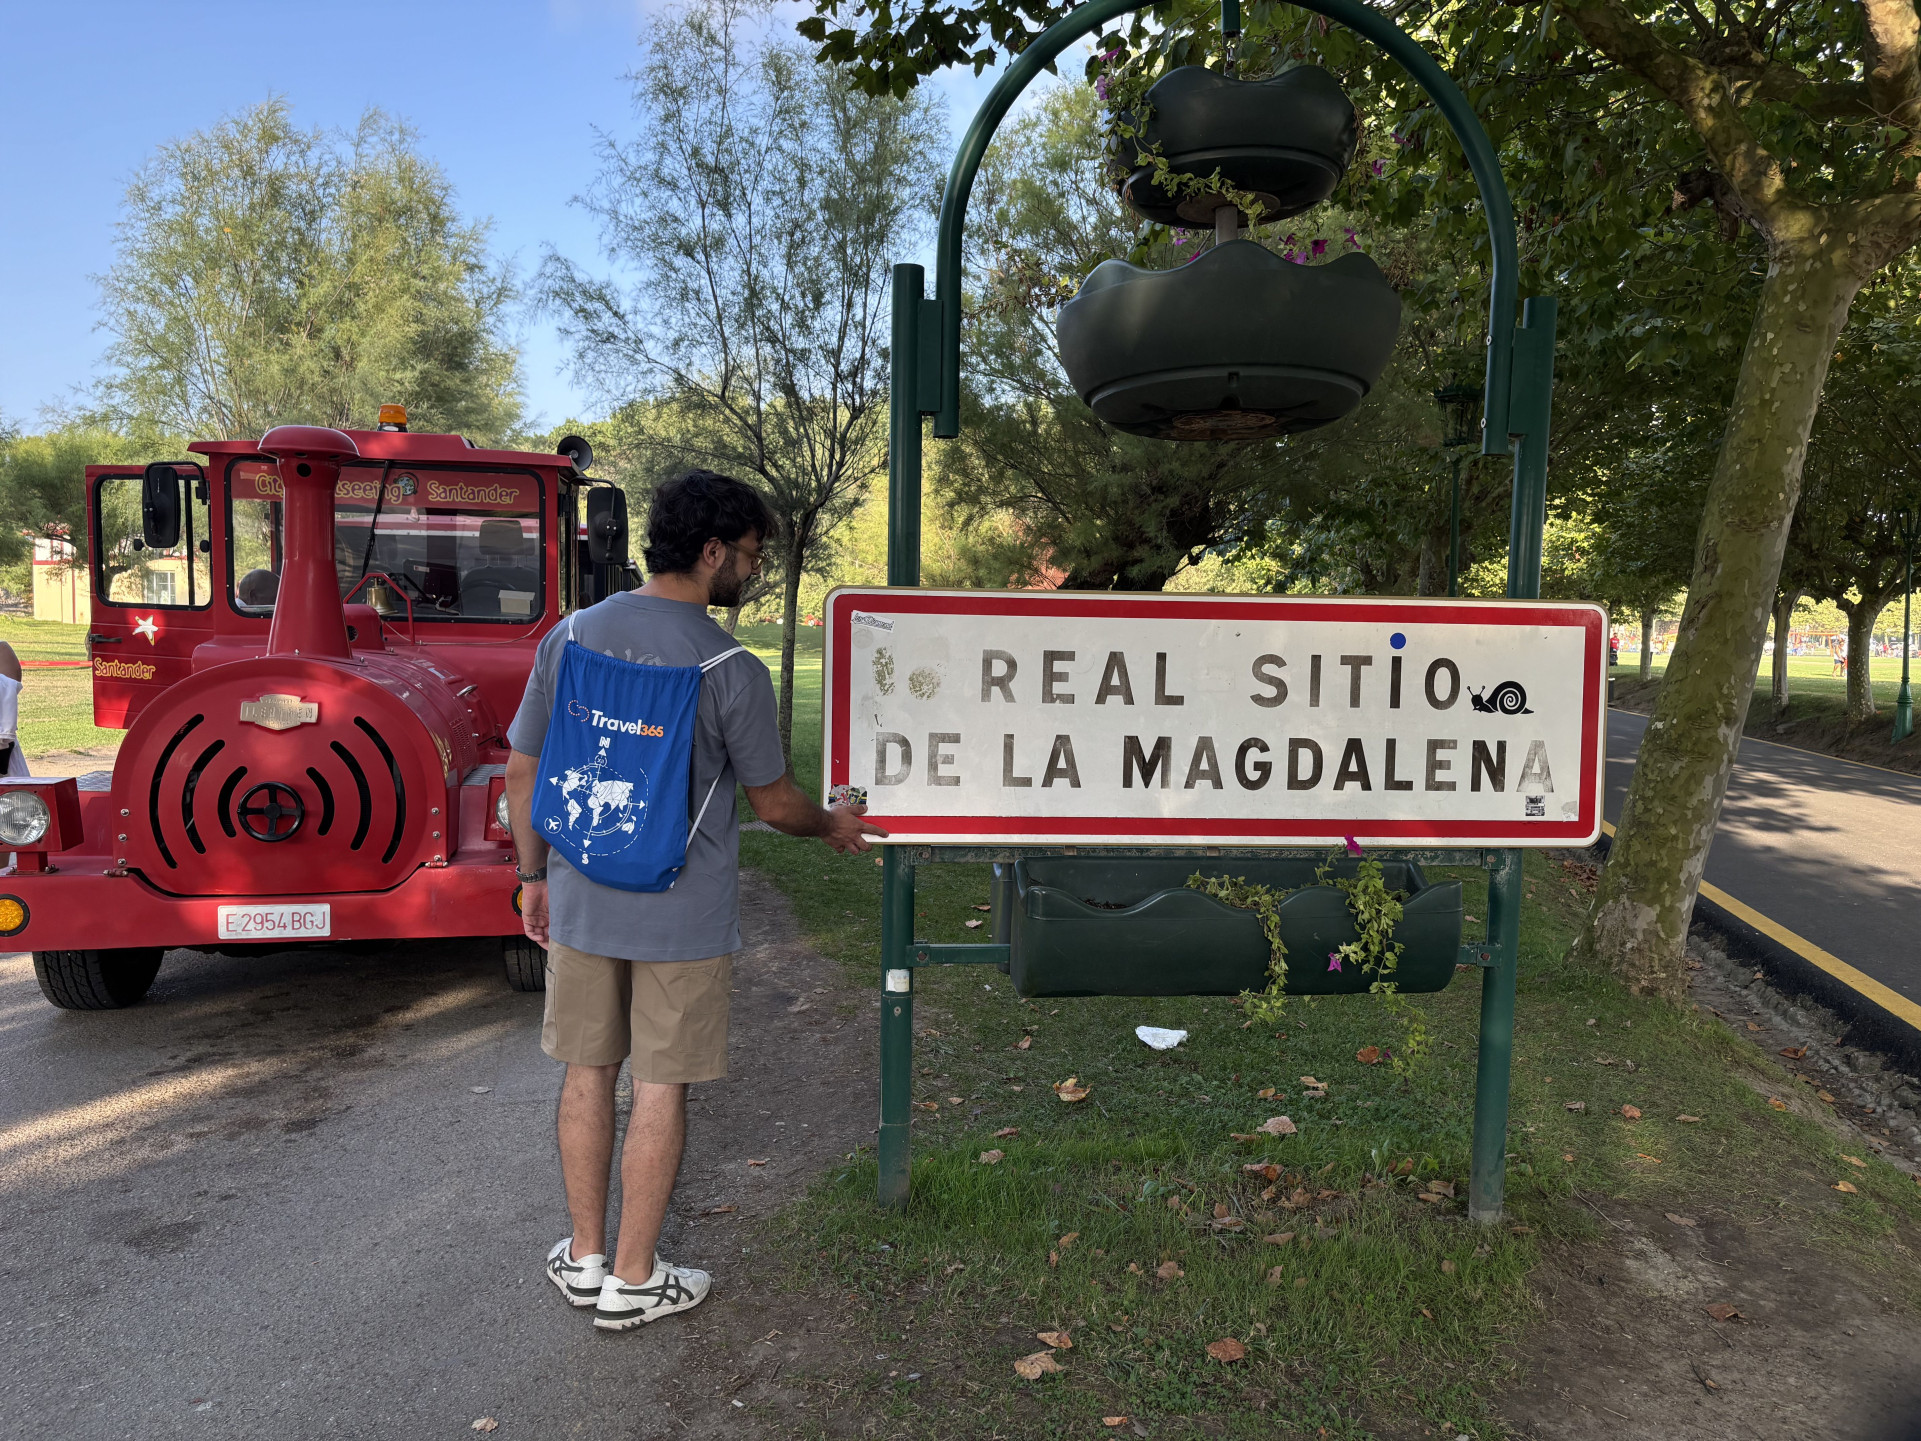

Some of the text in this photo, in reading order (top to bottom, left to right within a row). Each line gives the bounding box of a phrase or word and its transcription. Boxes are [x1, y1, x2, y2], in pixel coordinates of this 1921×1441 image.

[427, 480, 520, 504] Santander
[94, 657, 156, 680] Santander
[981, 649, 1461, 711] REAL SITIO
[591, 709, 664, 738] Travel365
[598, 736, 611, 749] N
[874, 731, 1555, 793] DE LA MAGDALENA
[581, 853, 589, 865] S
